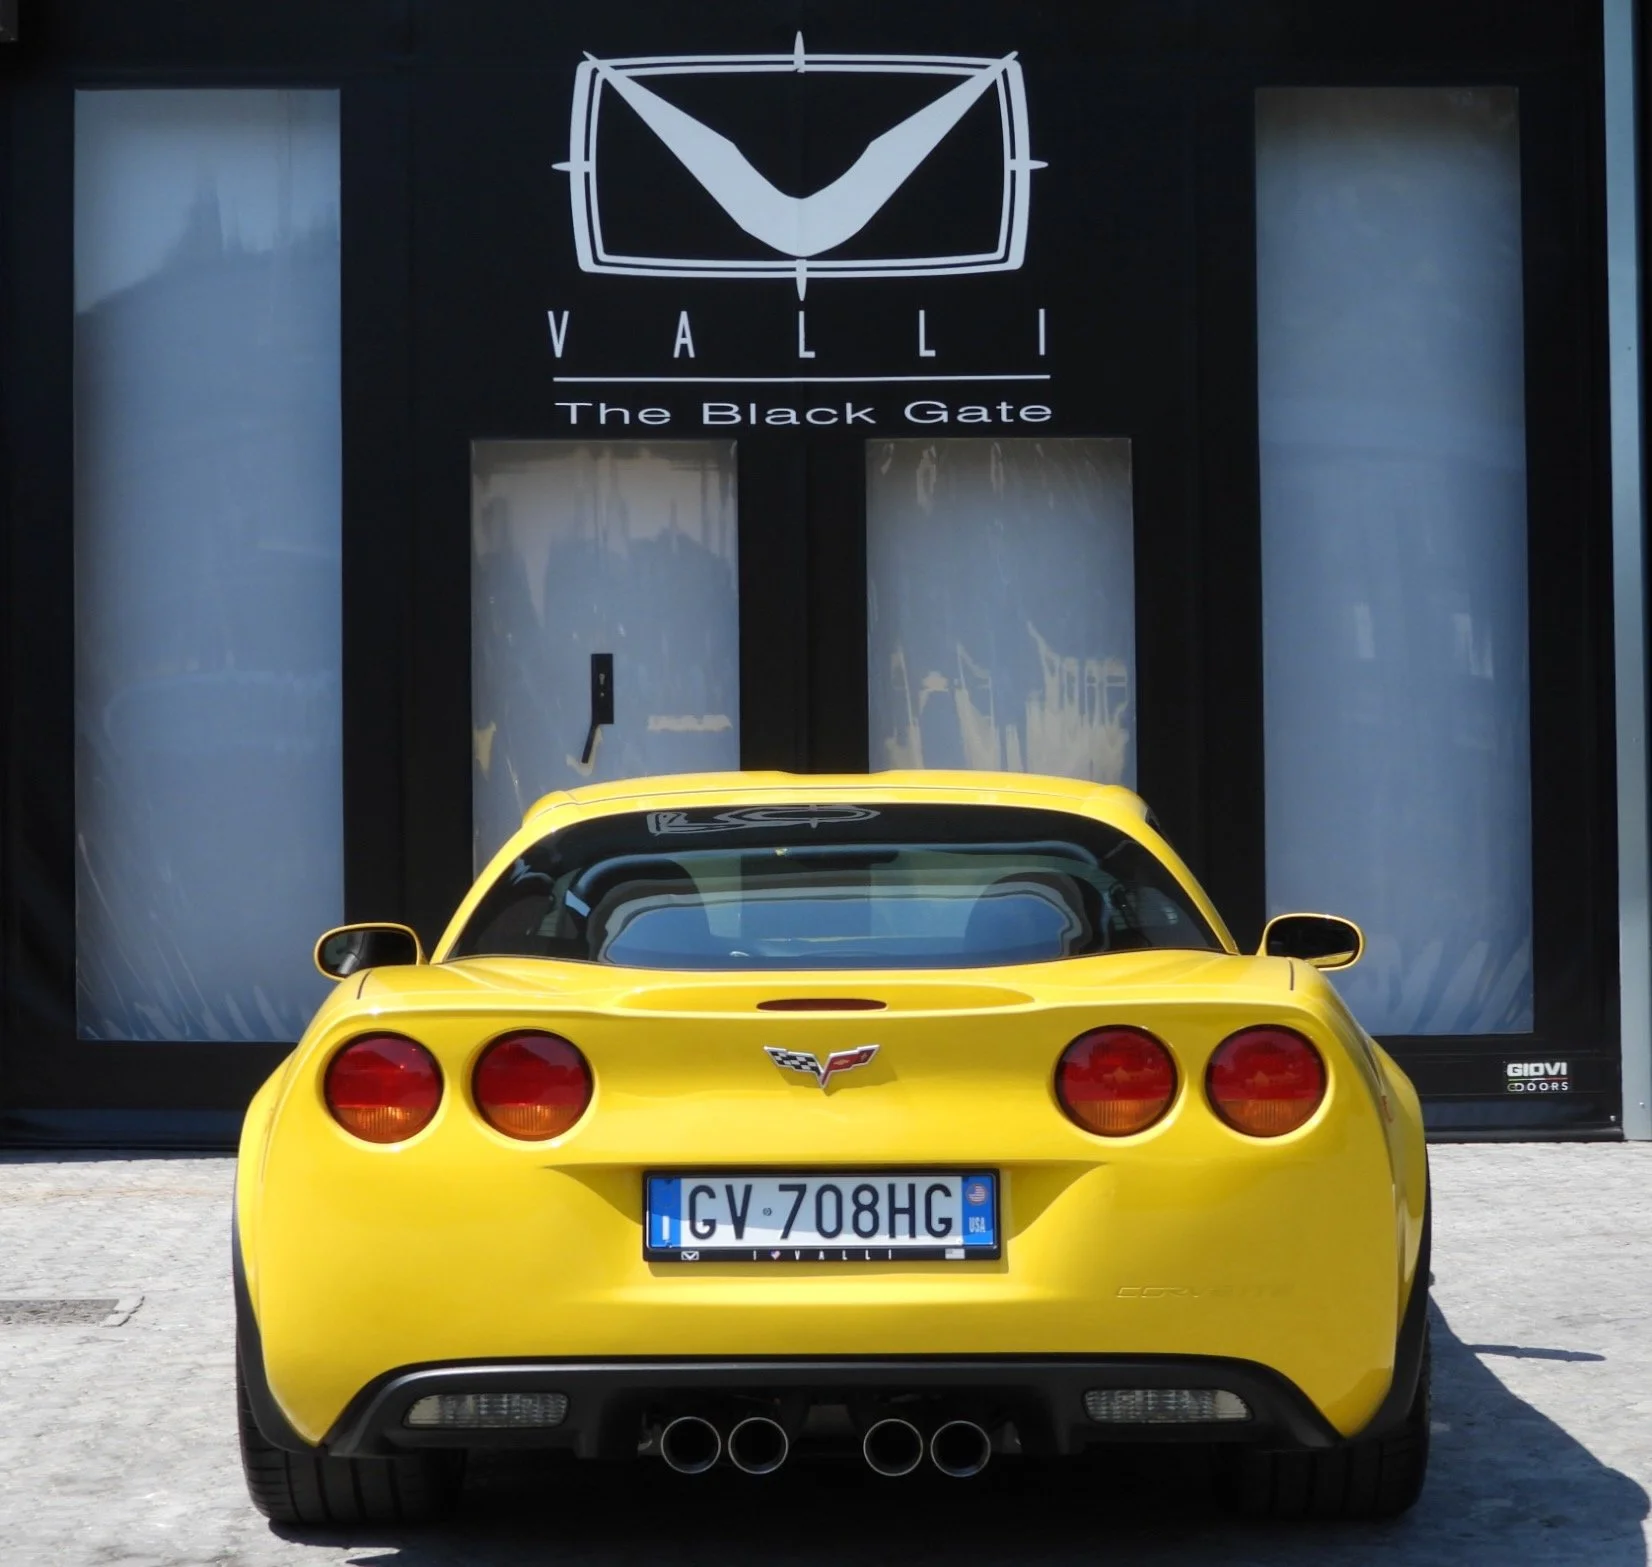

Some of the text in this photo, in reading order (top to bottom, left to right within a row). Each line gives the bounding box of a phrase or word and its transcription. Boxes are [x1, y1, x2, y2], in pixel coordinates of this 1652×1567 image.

[548, 308, 1045, 358] VALLI
[555, 400, 1052, 425] The Black Gate
[1507, 1062, 1567, 1077] GIOVI
[688, 1183, 953, 1240] GV 708HG
[968, 1216, 986, 1233] USA
[794, 1249, 892, 1261] VALLI
[1116, 1286, 1296, 1299] CORVE
